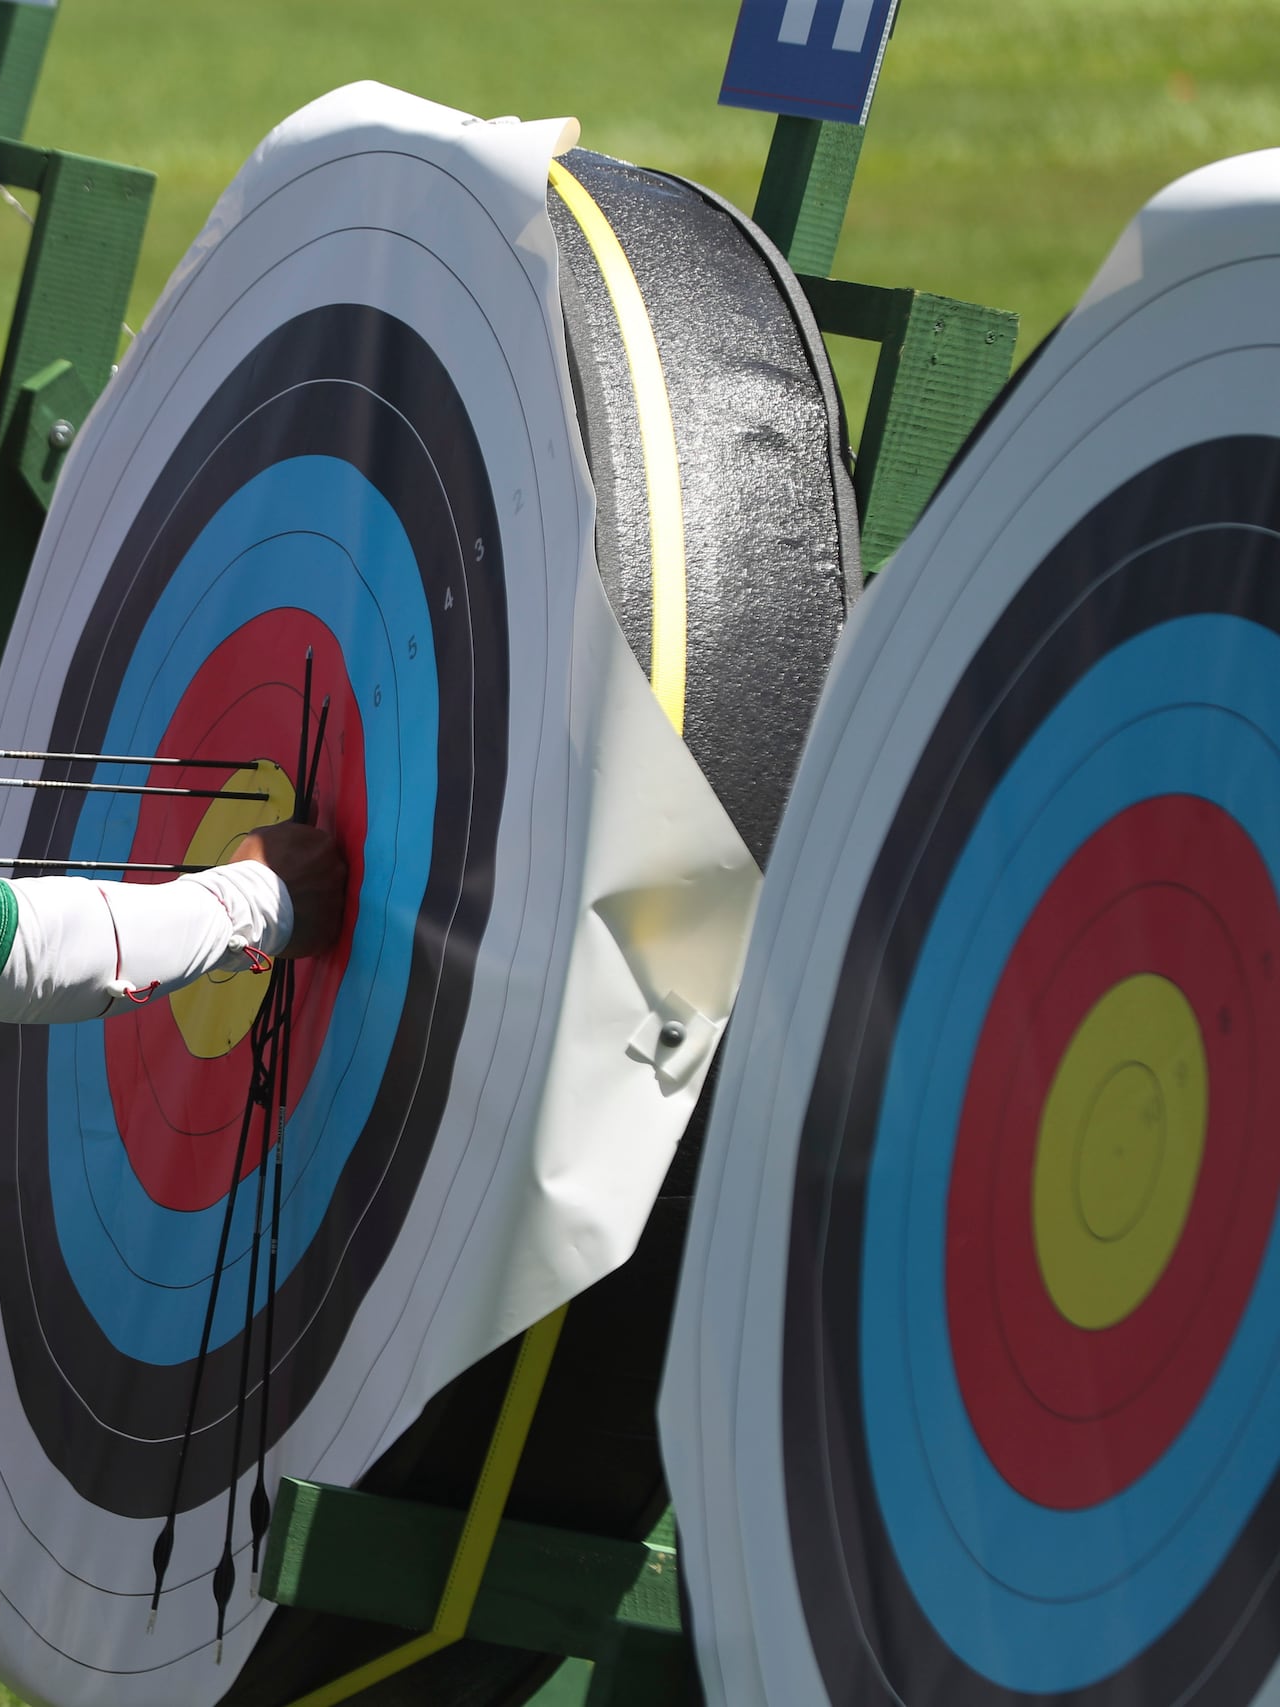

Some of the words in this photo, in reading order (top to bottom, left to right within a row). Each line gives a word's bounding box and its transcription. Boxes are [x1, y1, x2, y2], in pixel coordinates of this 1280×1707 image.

[513, 487, 524, 515] 2
[474, 537, 485, 562] 3
[444, 586, 454, 611] 4
[408, 634, 418, 660] 5
[373, 684, 382, 707] 6
